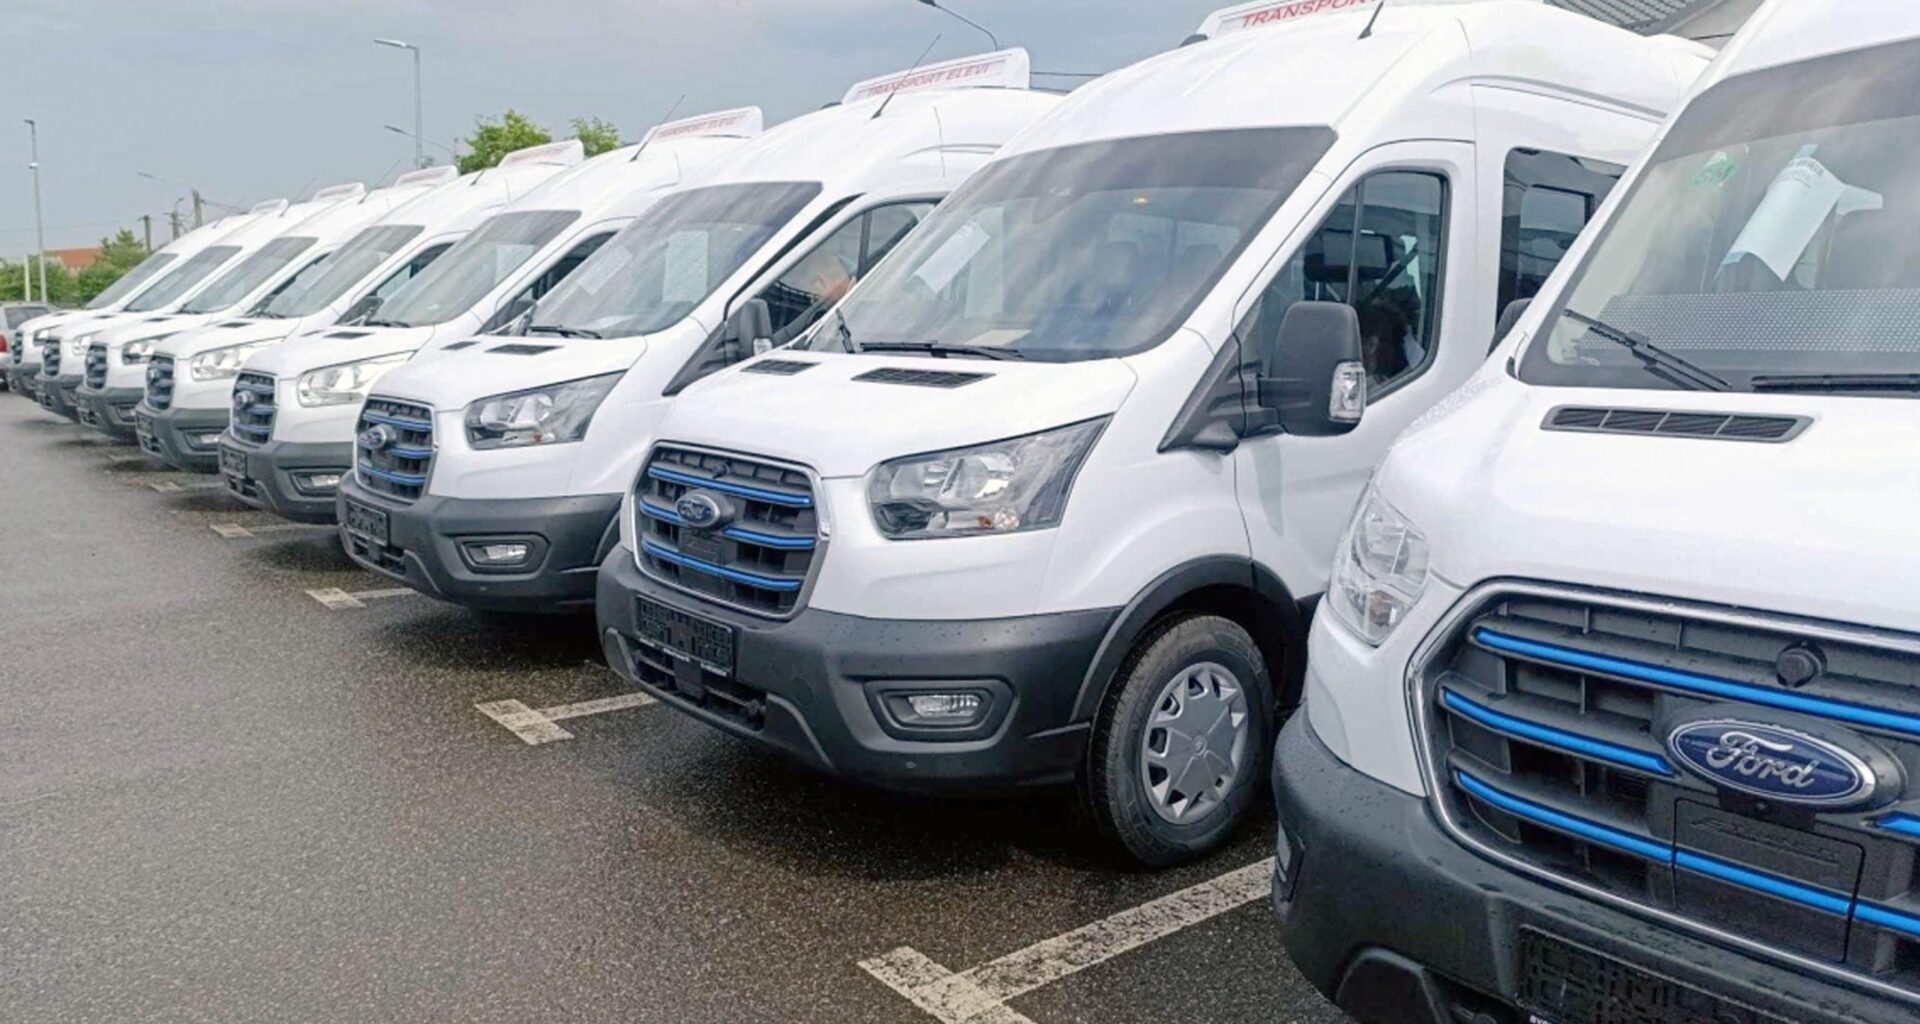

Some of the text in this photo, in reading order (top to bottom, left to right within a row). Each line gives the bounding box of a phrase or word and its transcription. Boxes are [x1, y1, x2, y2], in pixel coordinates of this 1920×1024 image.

[1242, 0, 1375, 27] TRANSPO
[946, 62, 990, 81] ELEVI
[1706, 731, 1820, 788] Ford
